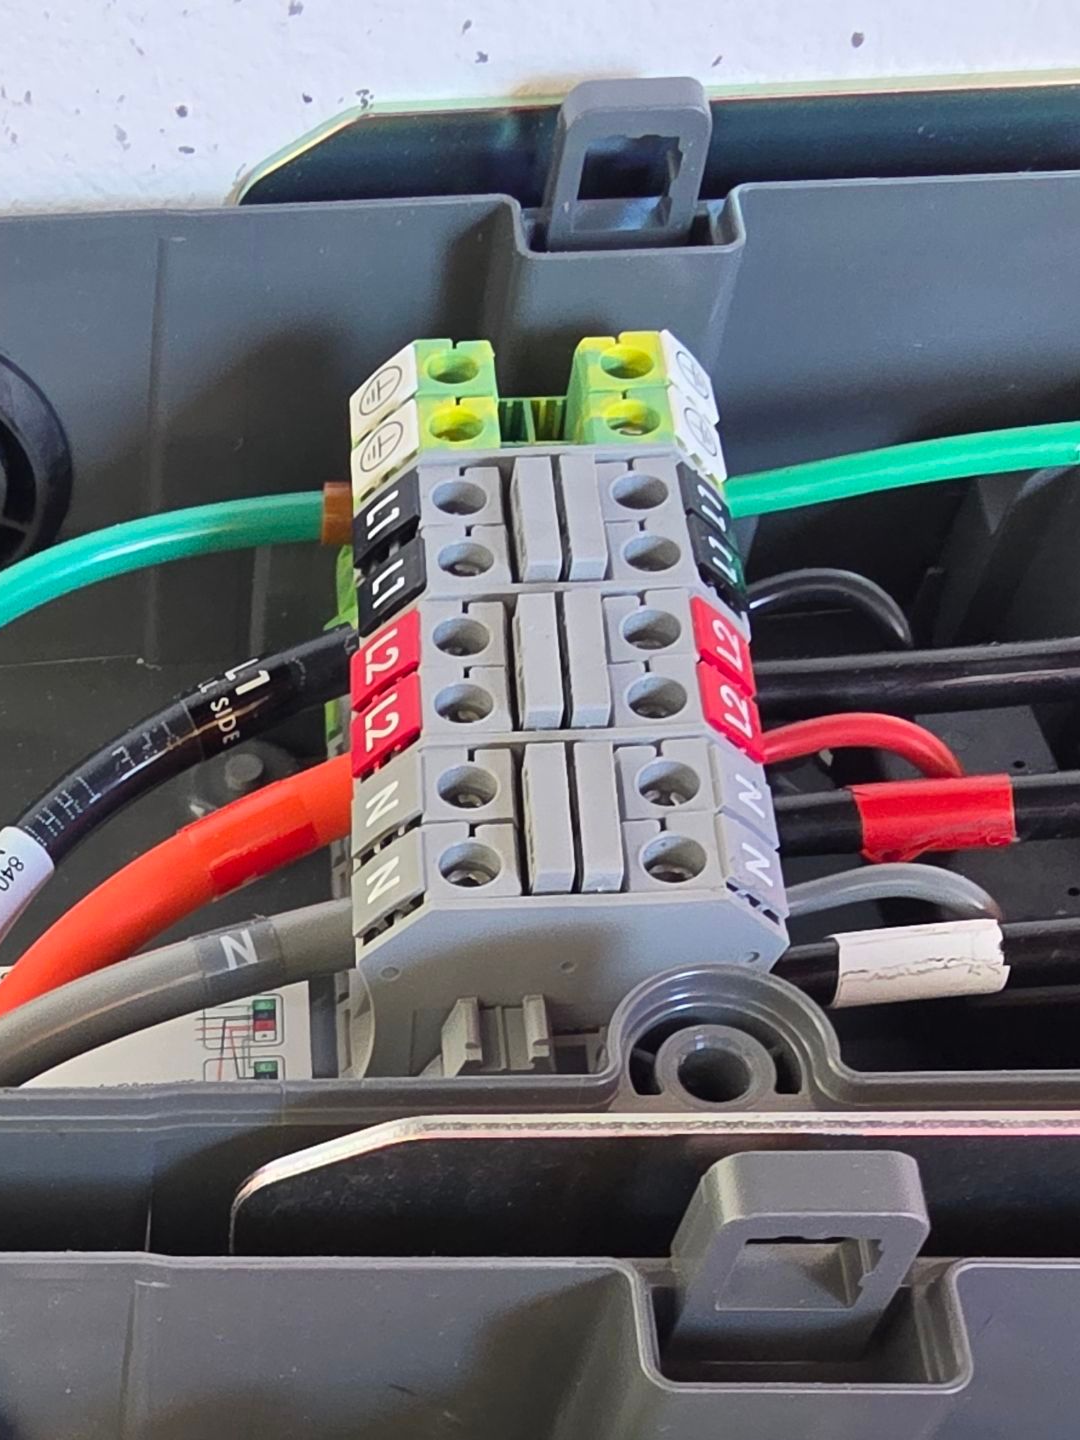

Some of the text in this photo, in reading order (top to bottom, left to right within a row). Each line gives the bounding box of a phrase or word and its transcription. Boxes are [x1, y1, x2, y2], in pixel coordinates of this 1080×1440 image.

[365, 490, 399, 537] L1
[371, 559, 405, 608] L1
[365, 627, 399, 681] L2
[713, 619, 742, 665] L2
[225, 658, 270, 696] L1
[211, 696, 240, 745] SIDE
[365, 693, 399, 751] L2
[719, 684, 753, 737] L2
[367, 780, 399, 825] N
[735, 773, 765, 817] N
[366, 856, 400, 903] N
[745, 842, 773, 887] N
[220, 929, 258, 970] N
